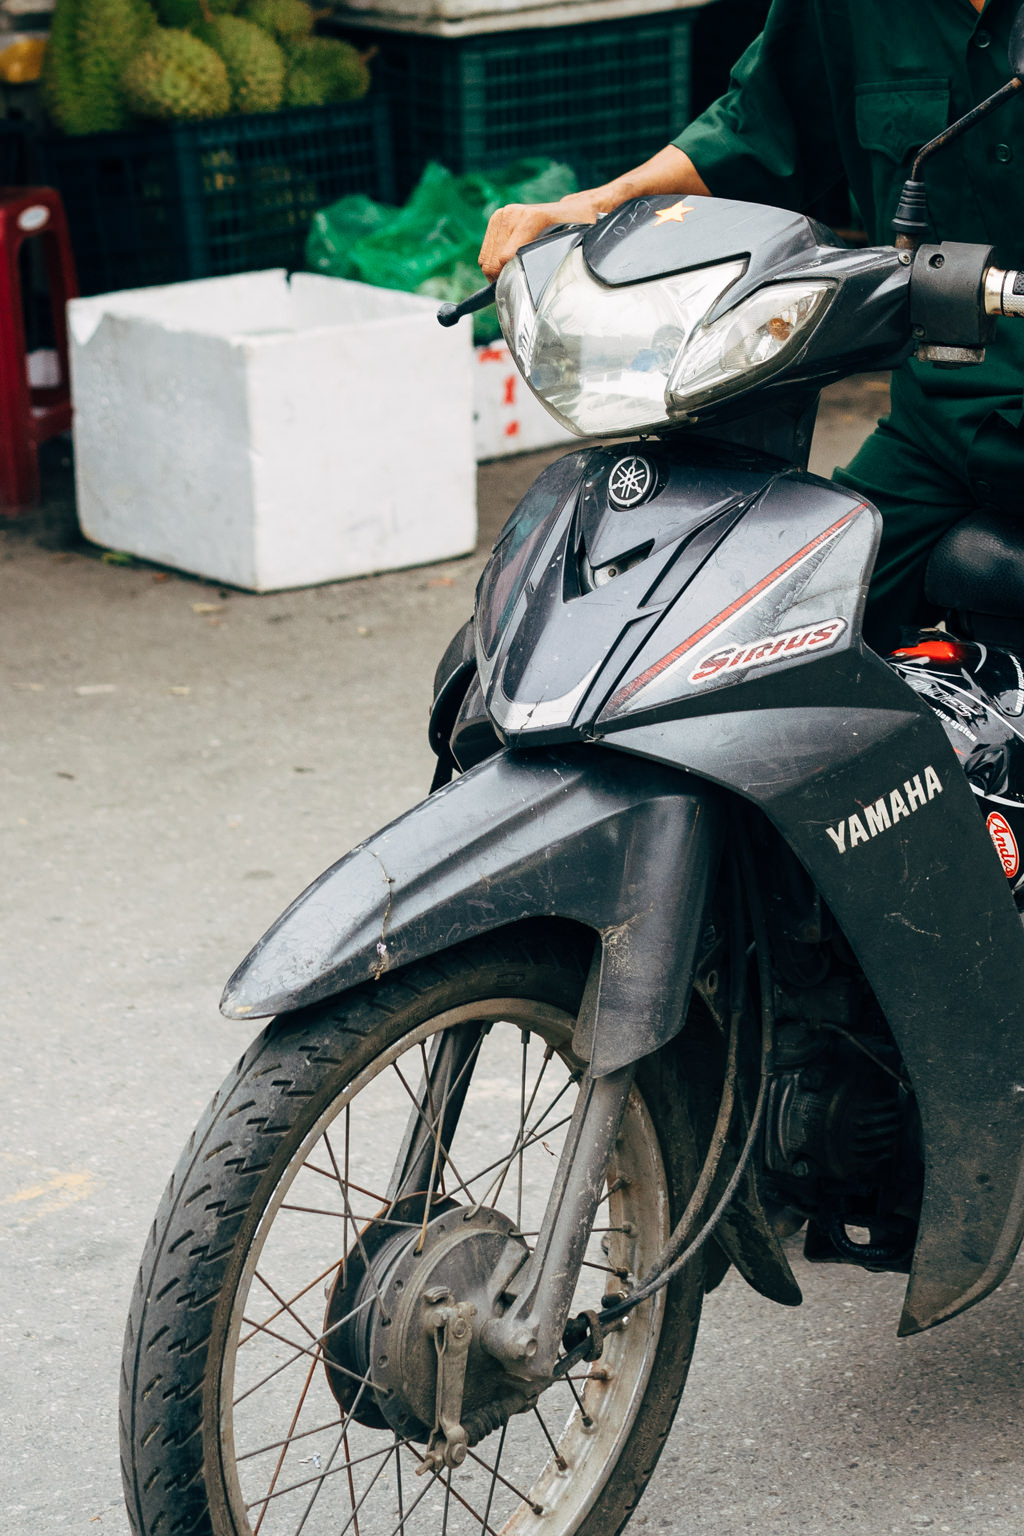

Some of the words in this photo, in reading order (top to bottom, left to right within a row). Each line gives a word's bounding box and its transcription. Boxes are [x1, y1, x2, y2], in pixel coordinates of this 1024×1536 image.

[950, 719, 978, 743] system
[825, 764, 943, 855] YAMAHA
[989, 816, 1016, 876] Andes
